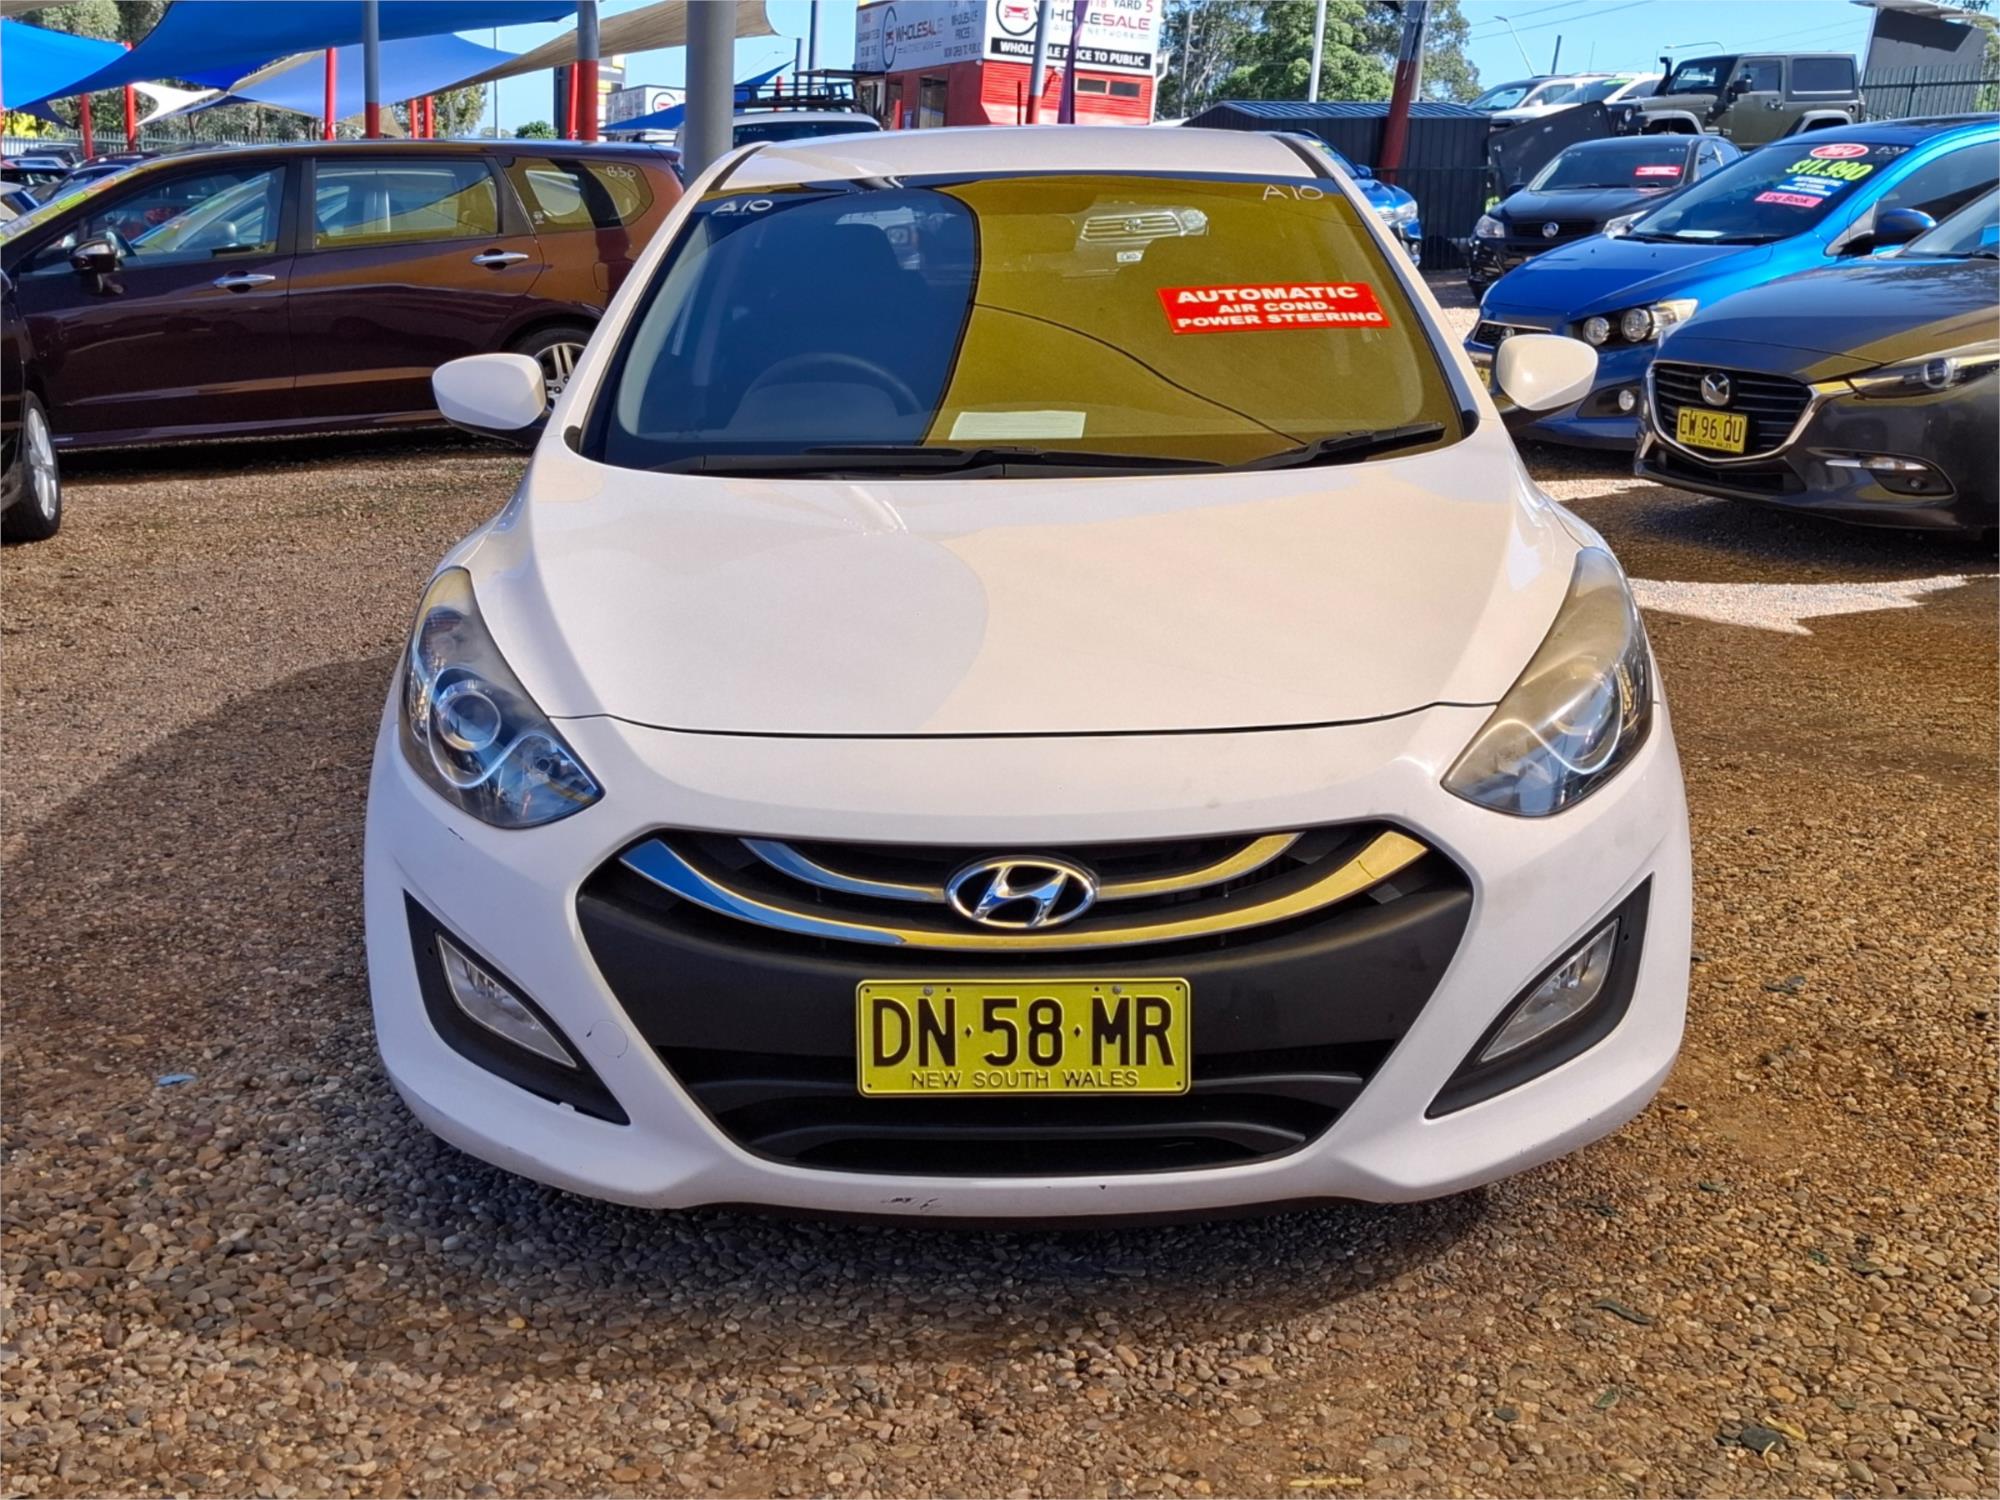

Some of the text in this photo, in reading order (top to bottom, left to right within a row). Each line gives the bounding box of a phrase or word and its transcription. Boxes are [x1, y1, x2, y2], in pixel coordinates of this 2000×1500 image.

[1094, 50, 1108, 63] TO
[1109, 52, 1145, 67] PUBLIC
[1262, 184, 1324, 201] A10
[711, 199, 774, 215] A10
[1176, 286, 1360, 304] AUTOMATIC
[1218, 301, 1336, 314] AIR COND.
[1177, 312, 1384, 328] POWER STEERING
[911, 1070, 1140, 1088] NEW SOUTH WALES
